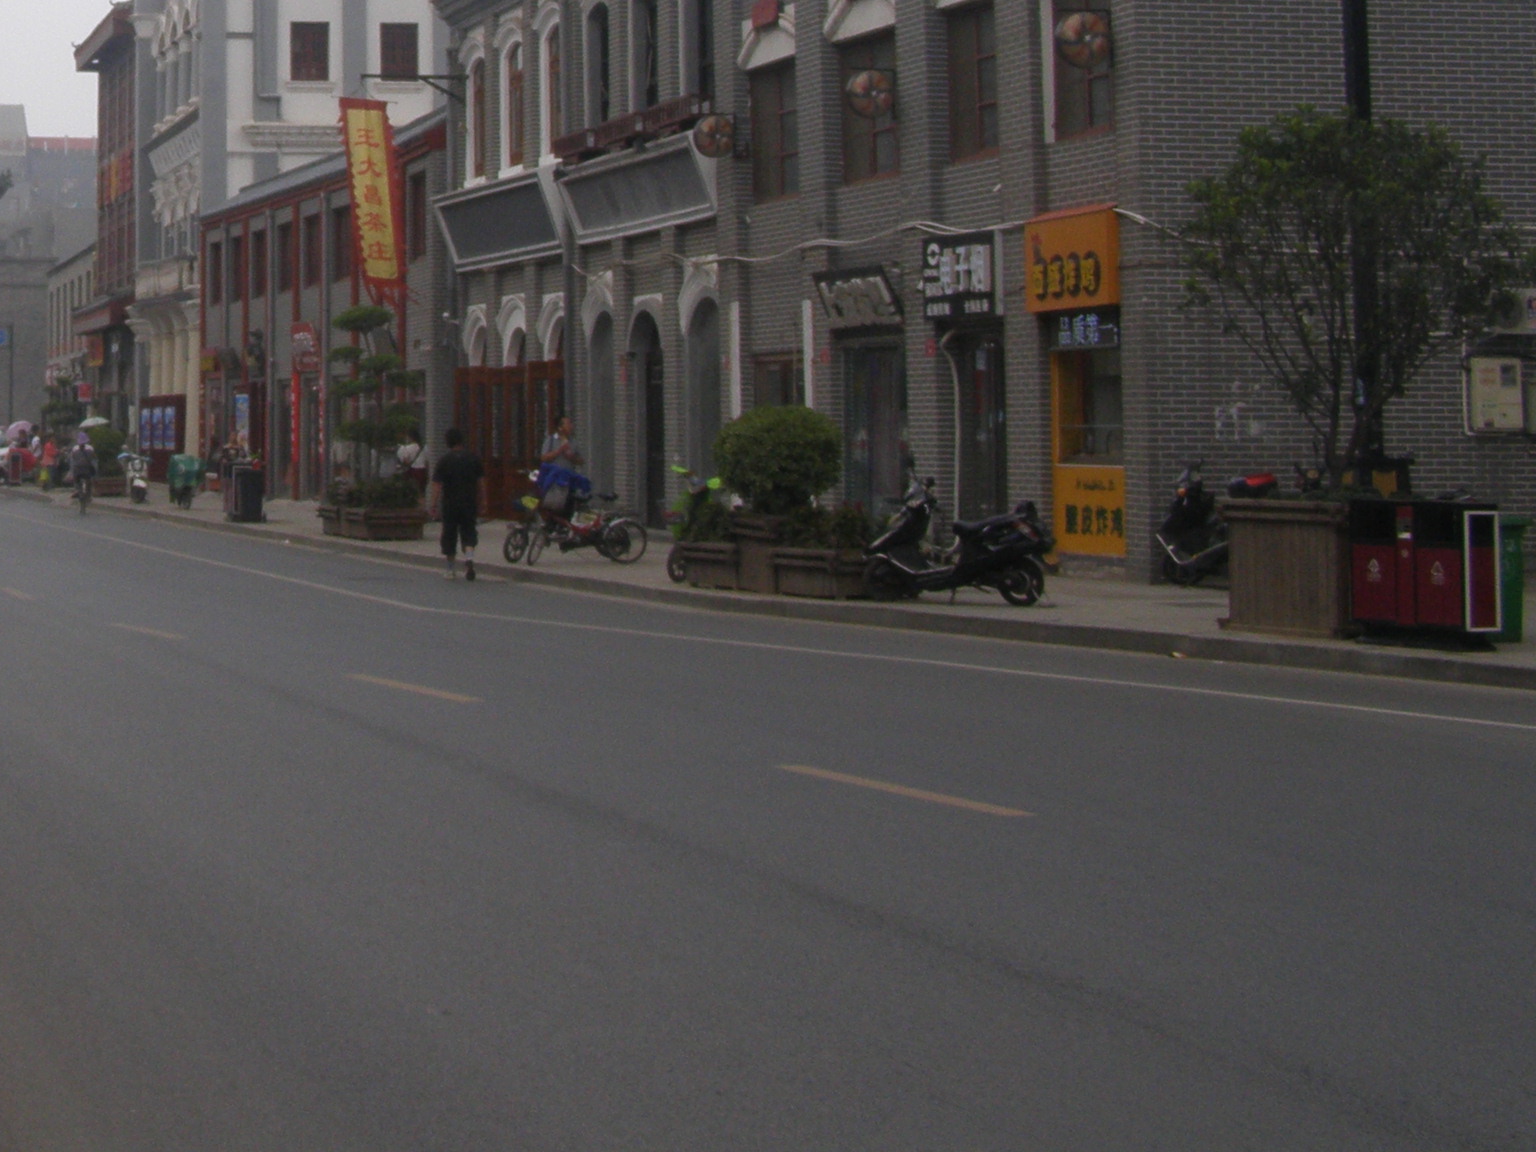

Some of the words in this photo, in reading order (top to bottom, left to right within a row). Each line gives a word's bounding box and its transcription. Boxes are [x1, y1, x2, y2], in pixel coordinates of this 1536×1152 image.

[355, 128, 392, 261] 王大昌茶庄
[940, 245, 989, 294] 电子烟
